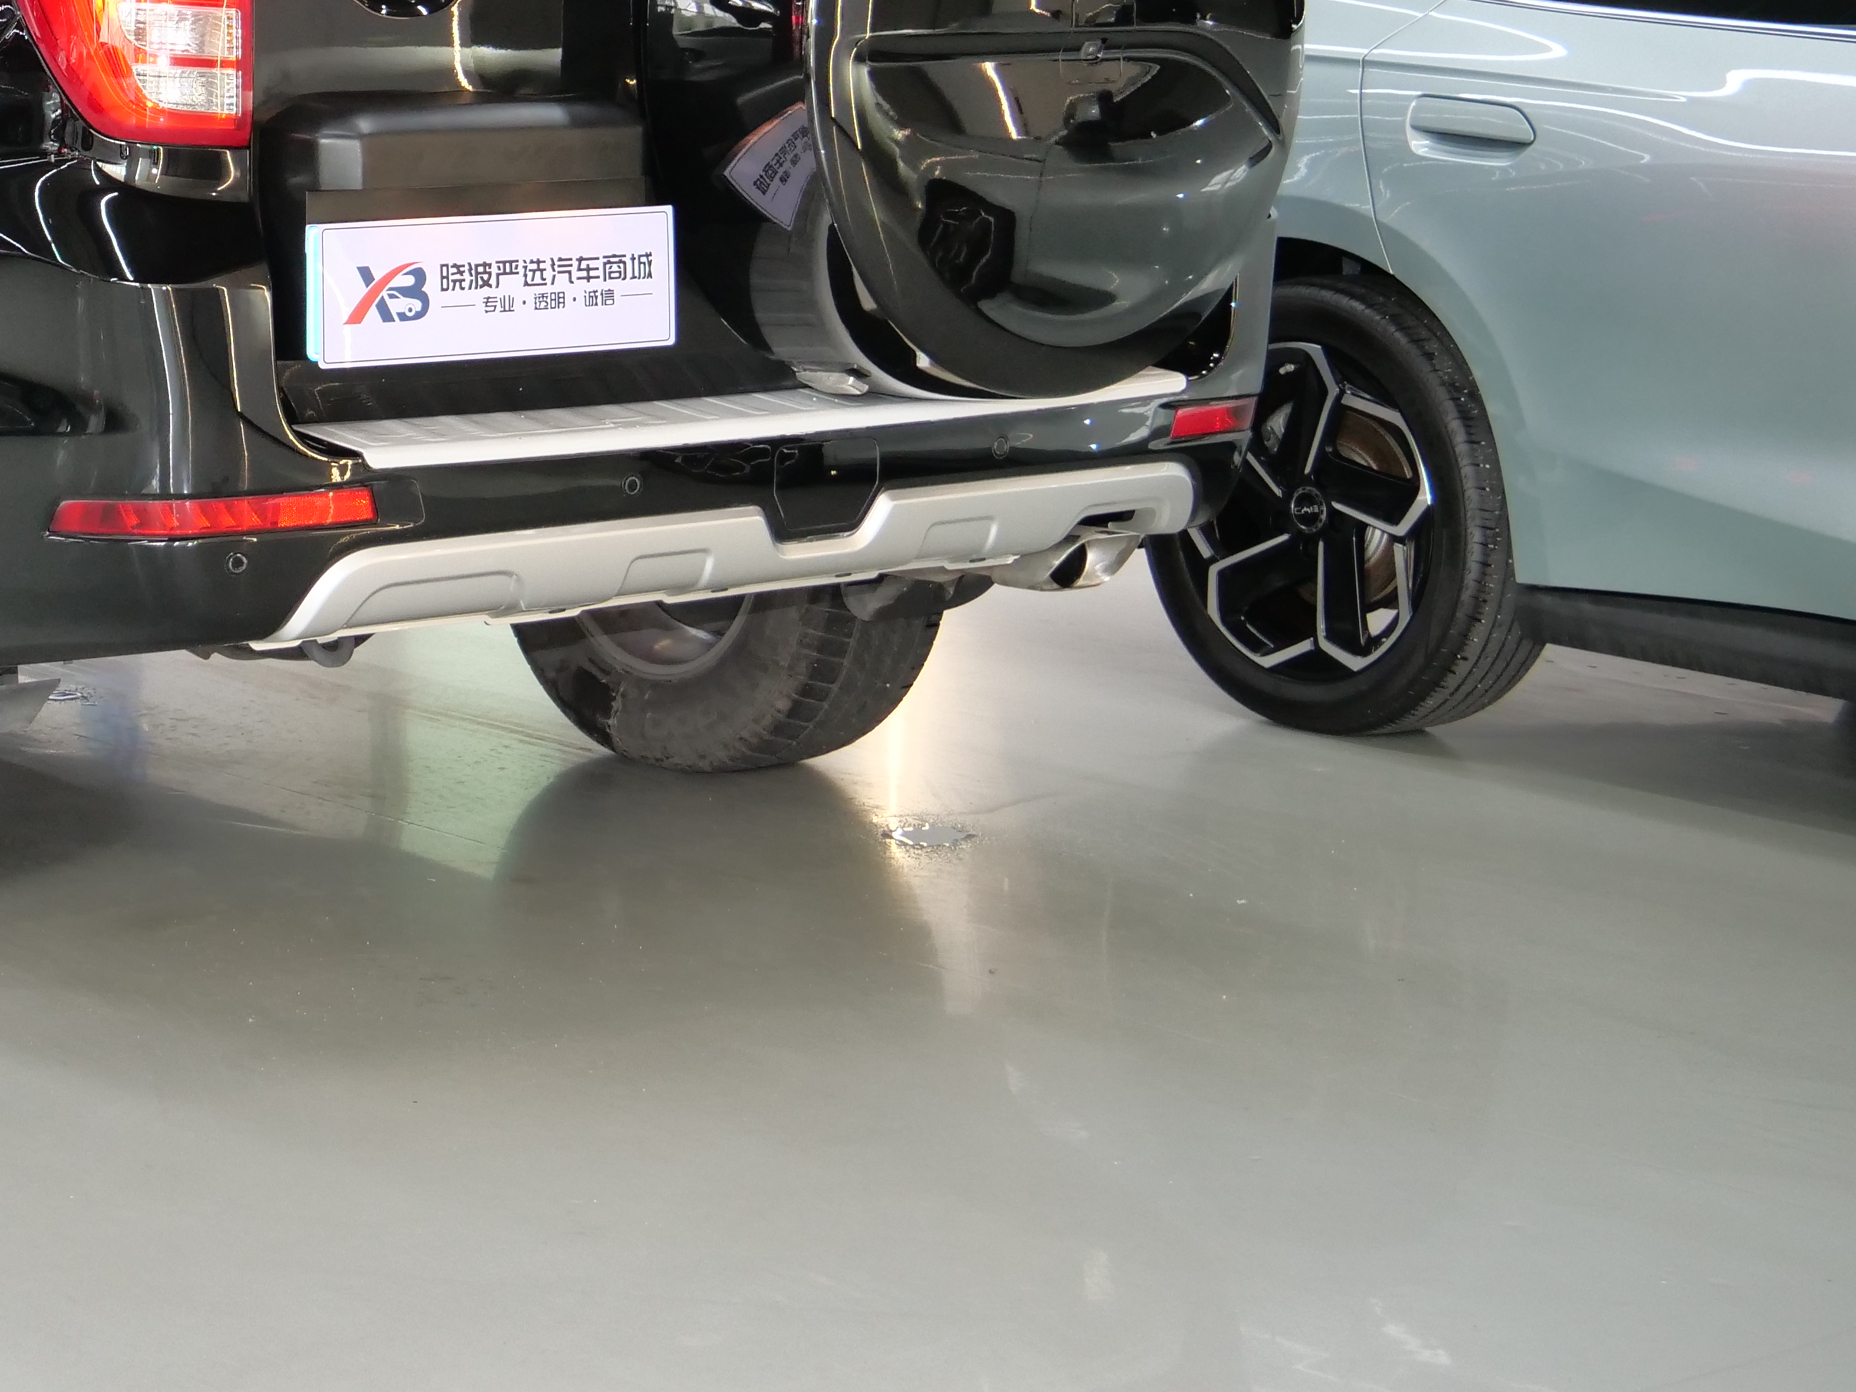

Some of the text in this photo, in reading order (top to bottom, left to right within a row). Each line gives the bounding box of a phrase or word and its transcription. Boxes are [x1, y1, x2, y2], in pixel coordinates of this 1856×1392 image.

[439, 250, 654, 293] 晓波严选汽车商城
